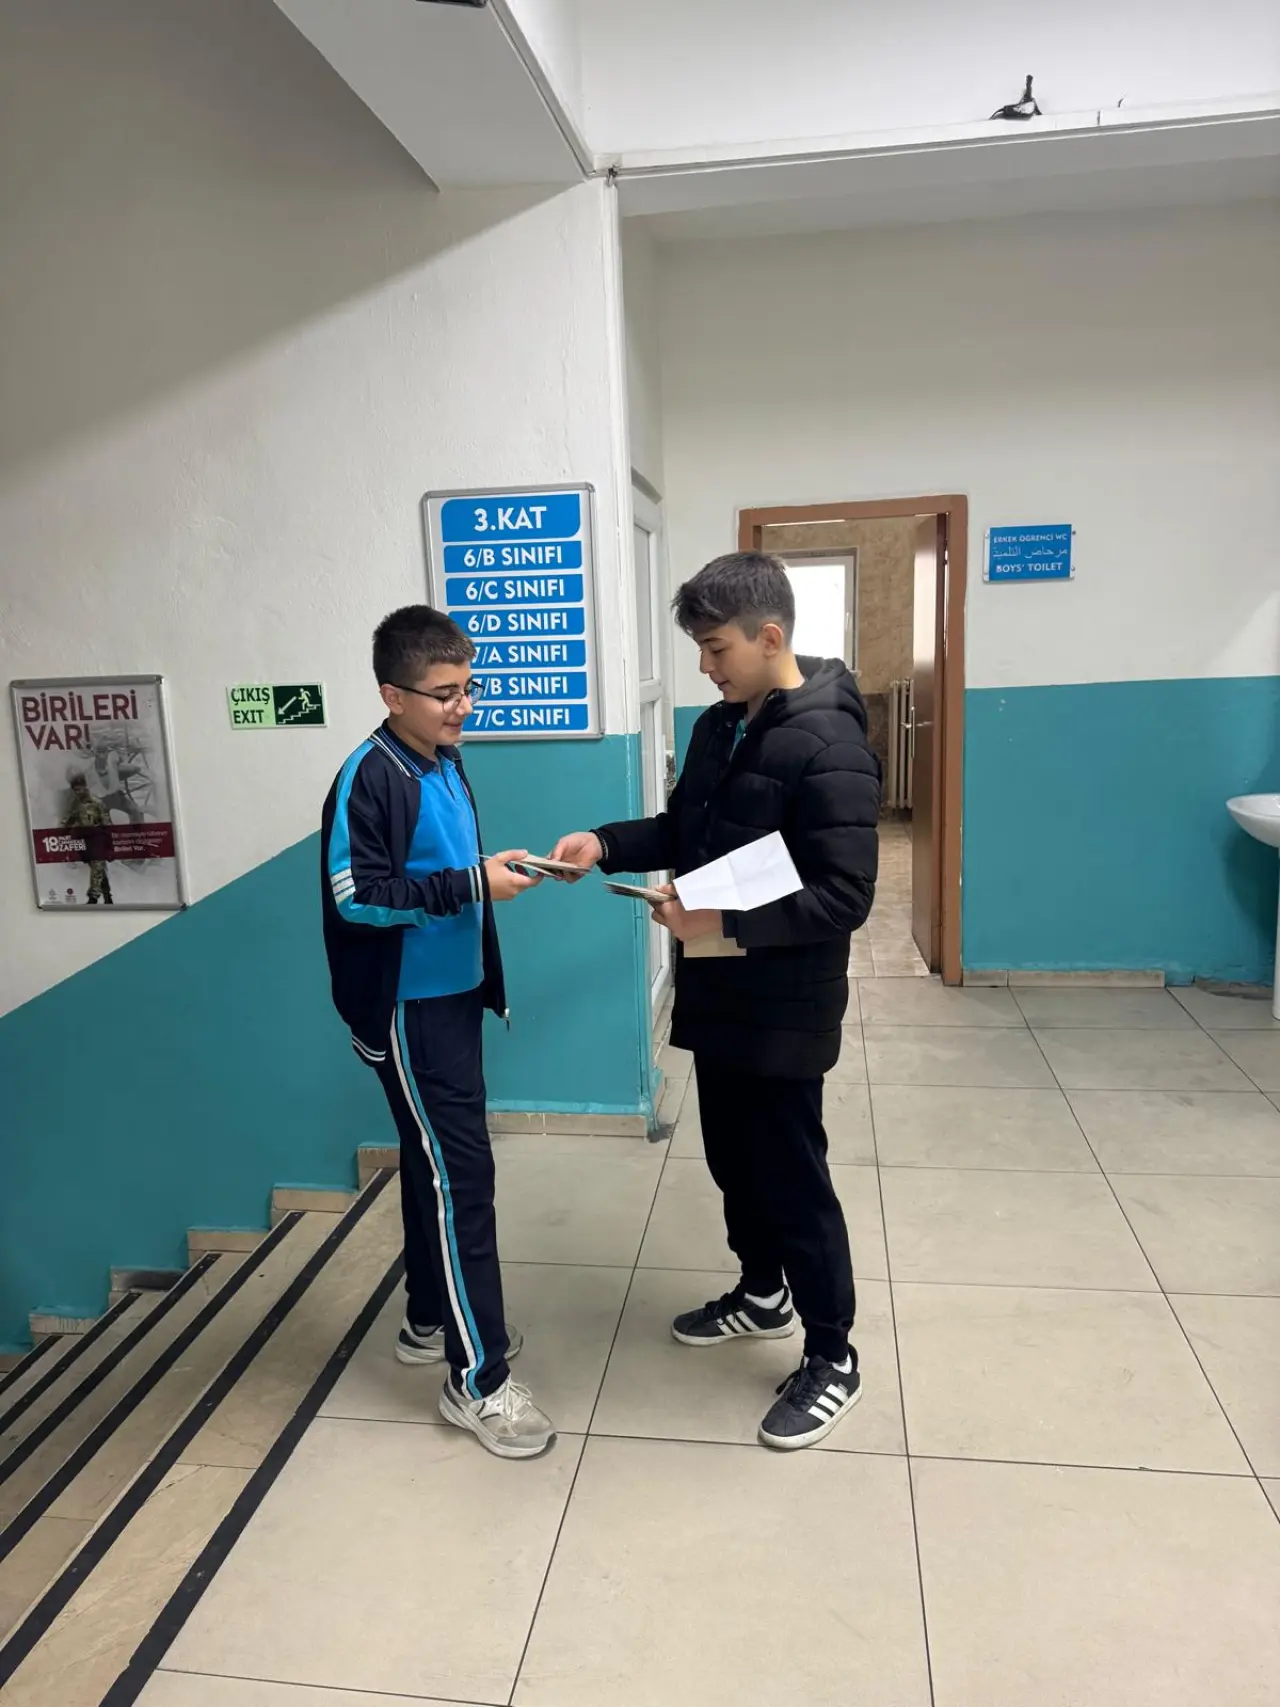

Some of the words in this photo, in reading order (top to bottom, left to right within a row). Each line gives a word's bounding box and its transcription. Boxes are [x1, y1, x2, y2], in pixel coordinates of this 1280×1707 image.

[473, 506, 547, 532] 3.KAT
[463, 547, 495, 568] 6/B
[501, 546, 562, 566] SINIFI
[1027, 562, 1063, 572] TOILET
[465, 580, 498, 602] 6/C
[504, 579, 565, 599] SINIFI
[467, 613, 501, 634] 6/D
[507, 612, 568, 632] SINIFI
[508, 644, 568, 663] SINIFI
[230, 687, 270, 705] ÇIKIŞ
[509, 676, 568, 695] SINIFI
[21, 689, 139, 723] BİRİLERİ
[233, 709, 264, 724] EXIT
[473, 709, 505, 729] 7/C
[511, 708, 570, 726] SINIFI
[25, 723, 92, 751] VAR!
[42, 835, 59, 853] 18
